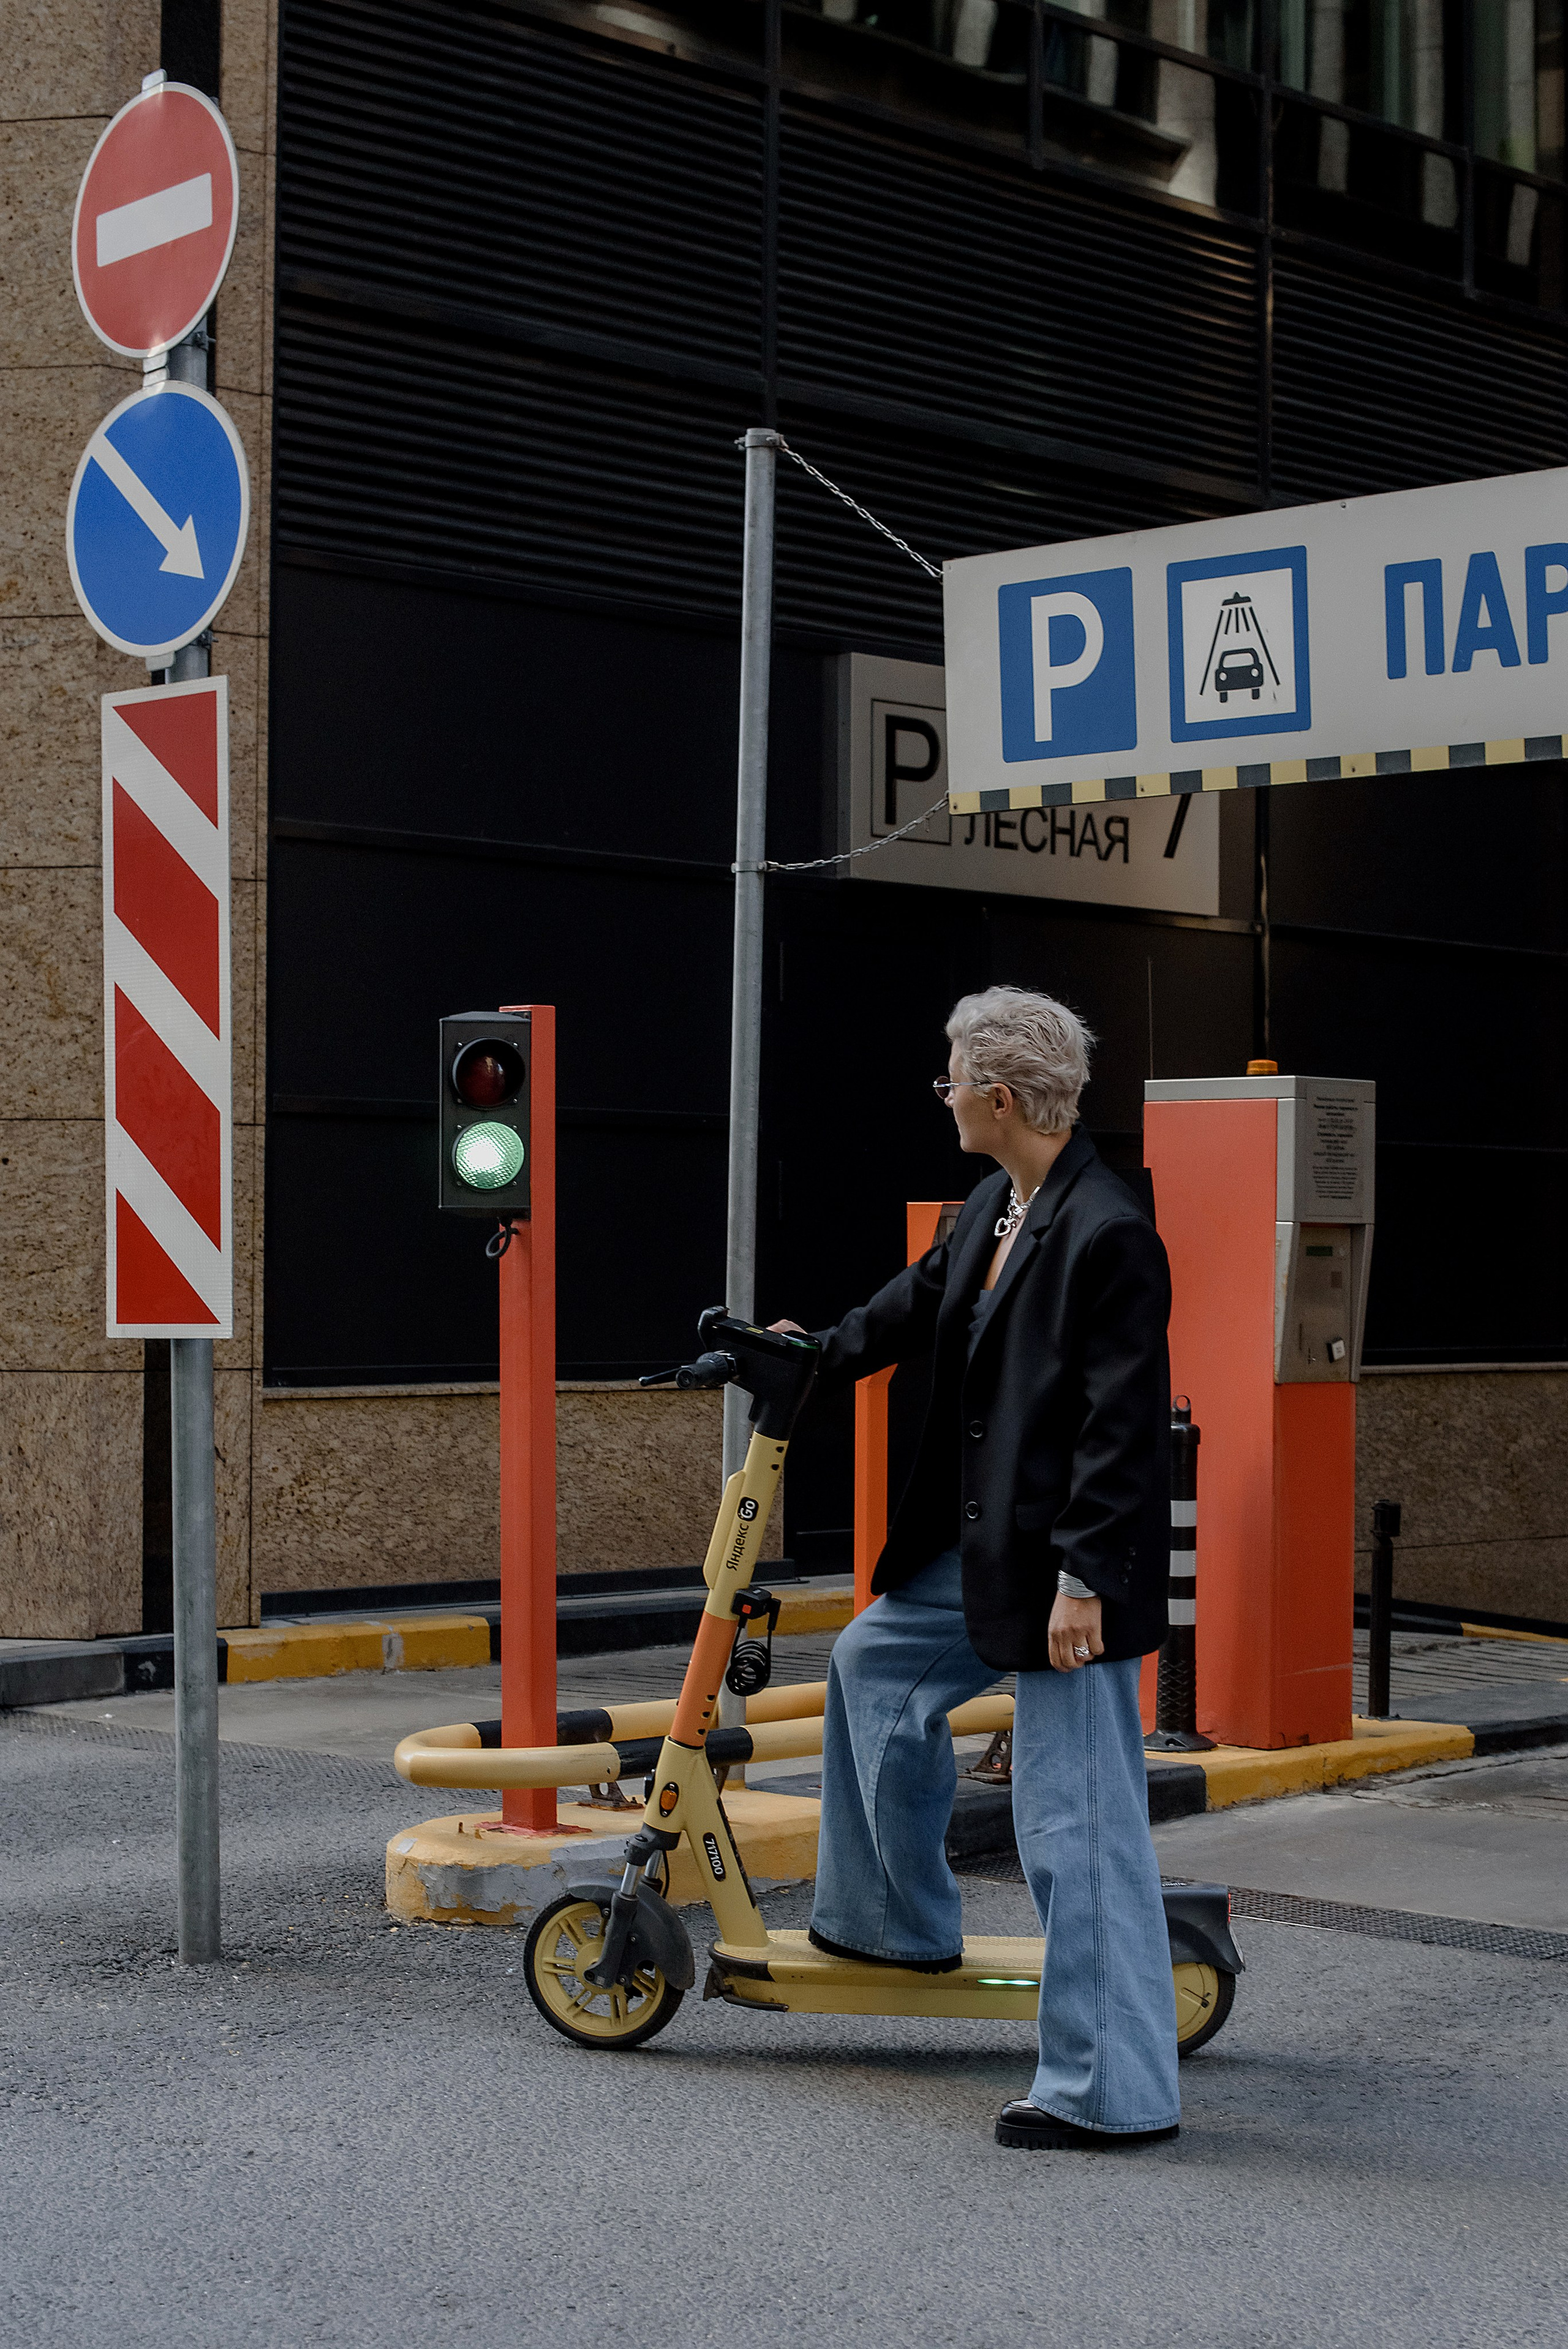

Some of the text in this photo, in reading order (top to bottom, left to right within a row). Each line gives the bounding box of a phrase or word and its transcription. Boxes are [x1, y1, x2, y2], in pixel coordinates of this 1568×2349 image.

[1384, 543, 1568, 679] ПАР
[1031, 592, 1103, 742] P
[885, 714, 941, 825] P
[963, 806, 1129, 863] ЛЕСНАЯ
[726, 1500, 755, 1571] Яндекс Go
[705, 1839, 723, 1874] 717100
